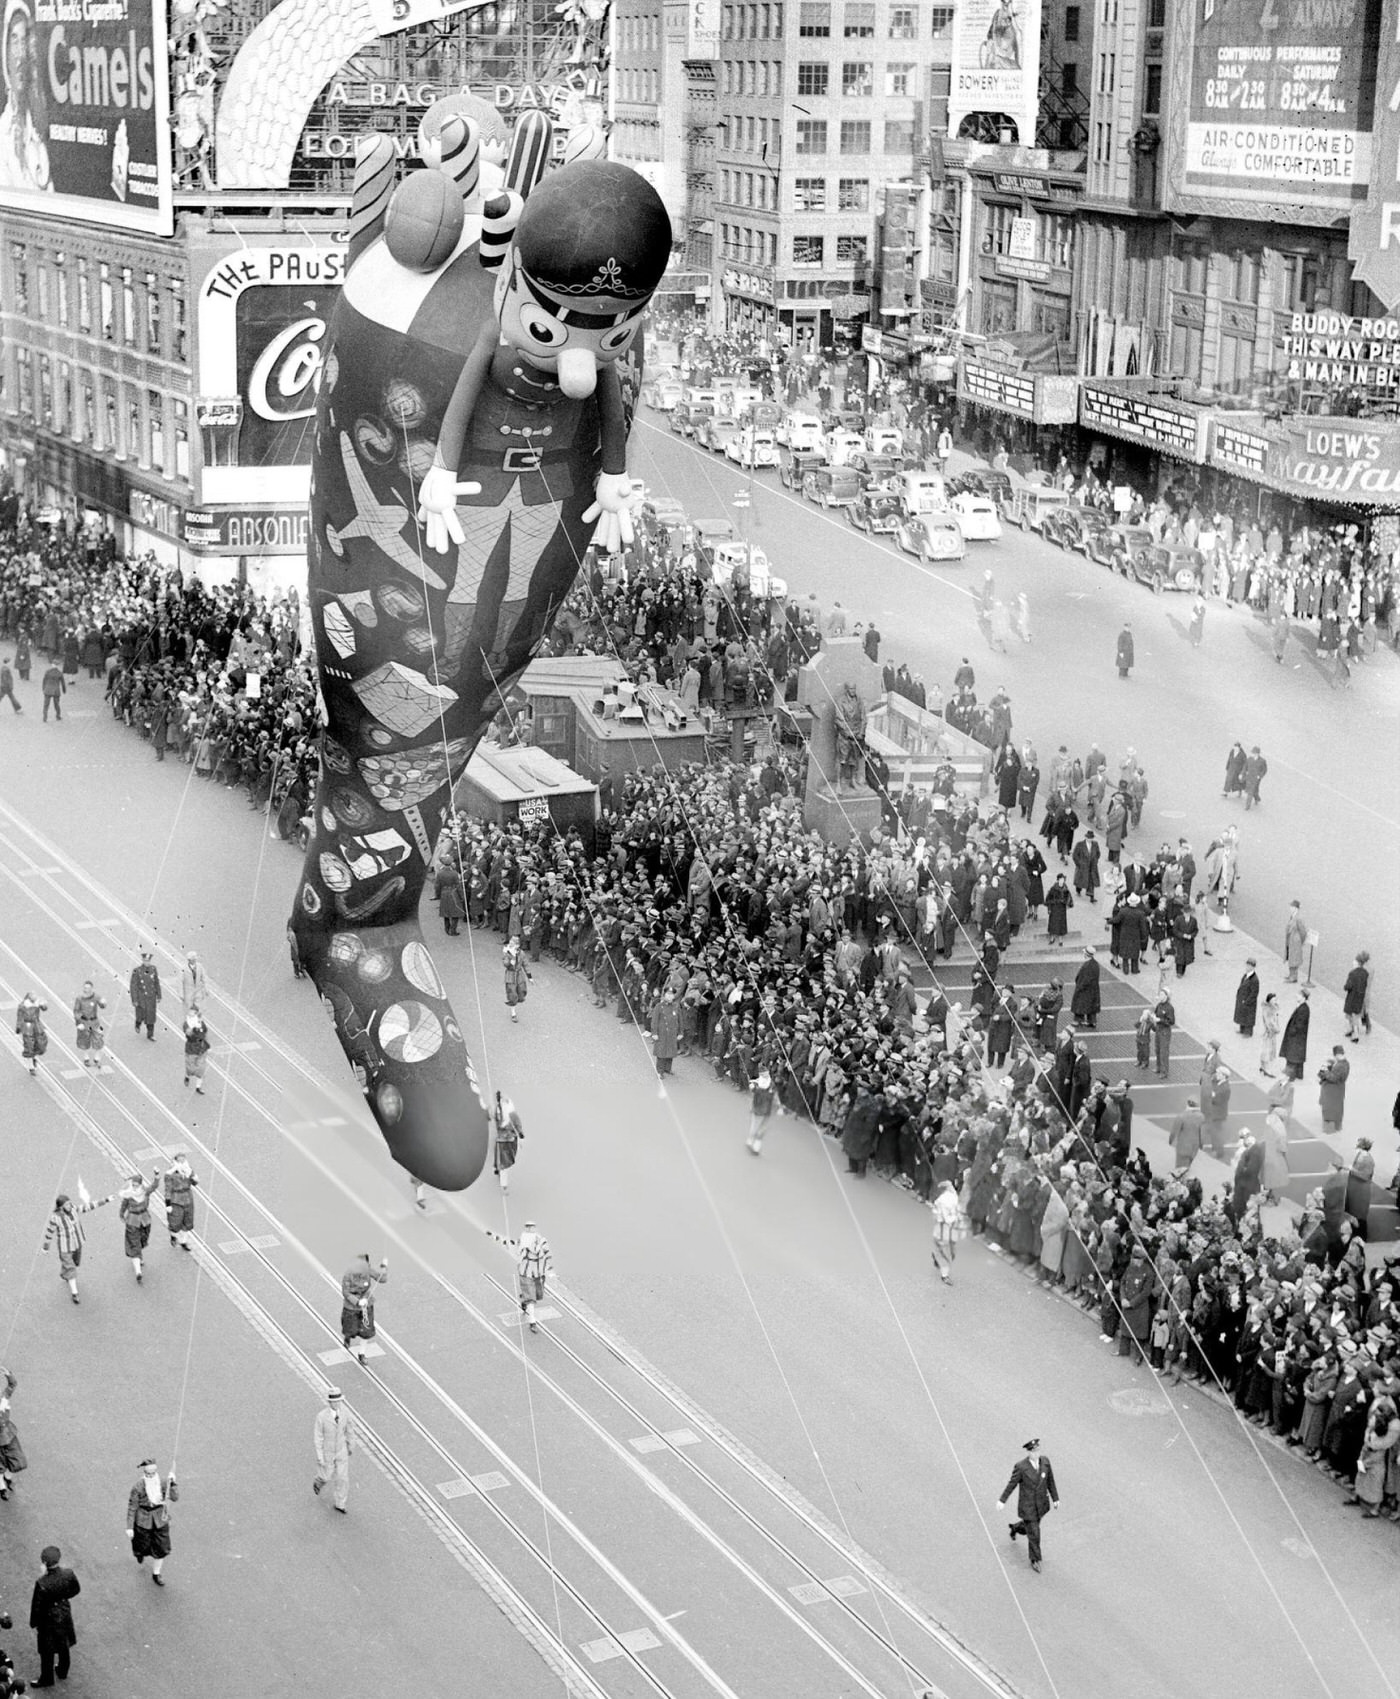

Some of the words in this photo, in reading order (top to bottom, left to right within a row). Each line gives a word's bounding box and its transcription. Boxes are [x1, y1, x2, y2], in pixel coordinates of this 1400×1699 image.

[1218, 46, 1272, 61] CONTINUOUS
[1276, 46, 1342, 62] PERFORMANCES
[49, 25, 153, 110] Camels
[1217, 64, 1247, 79] DAILY
[1292, 64, 1339, 81] SATURDAY
[959, 74, 999, 91] BOWERY
[328, 83, 348, 106] A
[370, 83, 437, 107] BAG
[495, 84, 558, 108] DAY
[1244, 153, 1353, 177] COMFORTABLE
[207, 260, 260, 300] THE
[1292, 313, 1354, 336] BUDDY
[1282, 336, 1322, 358] THIS
[1326, 339, 1363, 362] WAY
[1288, 359, 1301, 380] &
[1305, 361, 1343, 383] MAN
[1350, 364, 1368, 385] IN
[1306, 430, 1381, 460] LOEW'S
[520, 806, 547, 816] WORK
